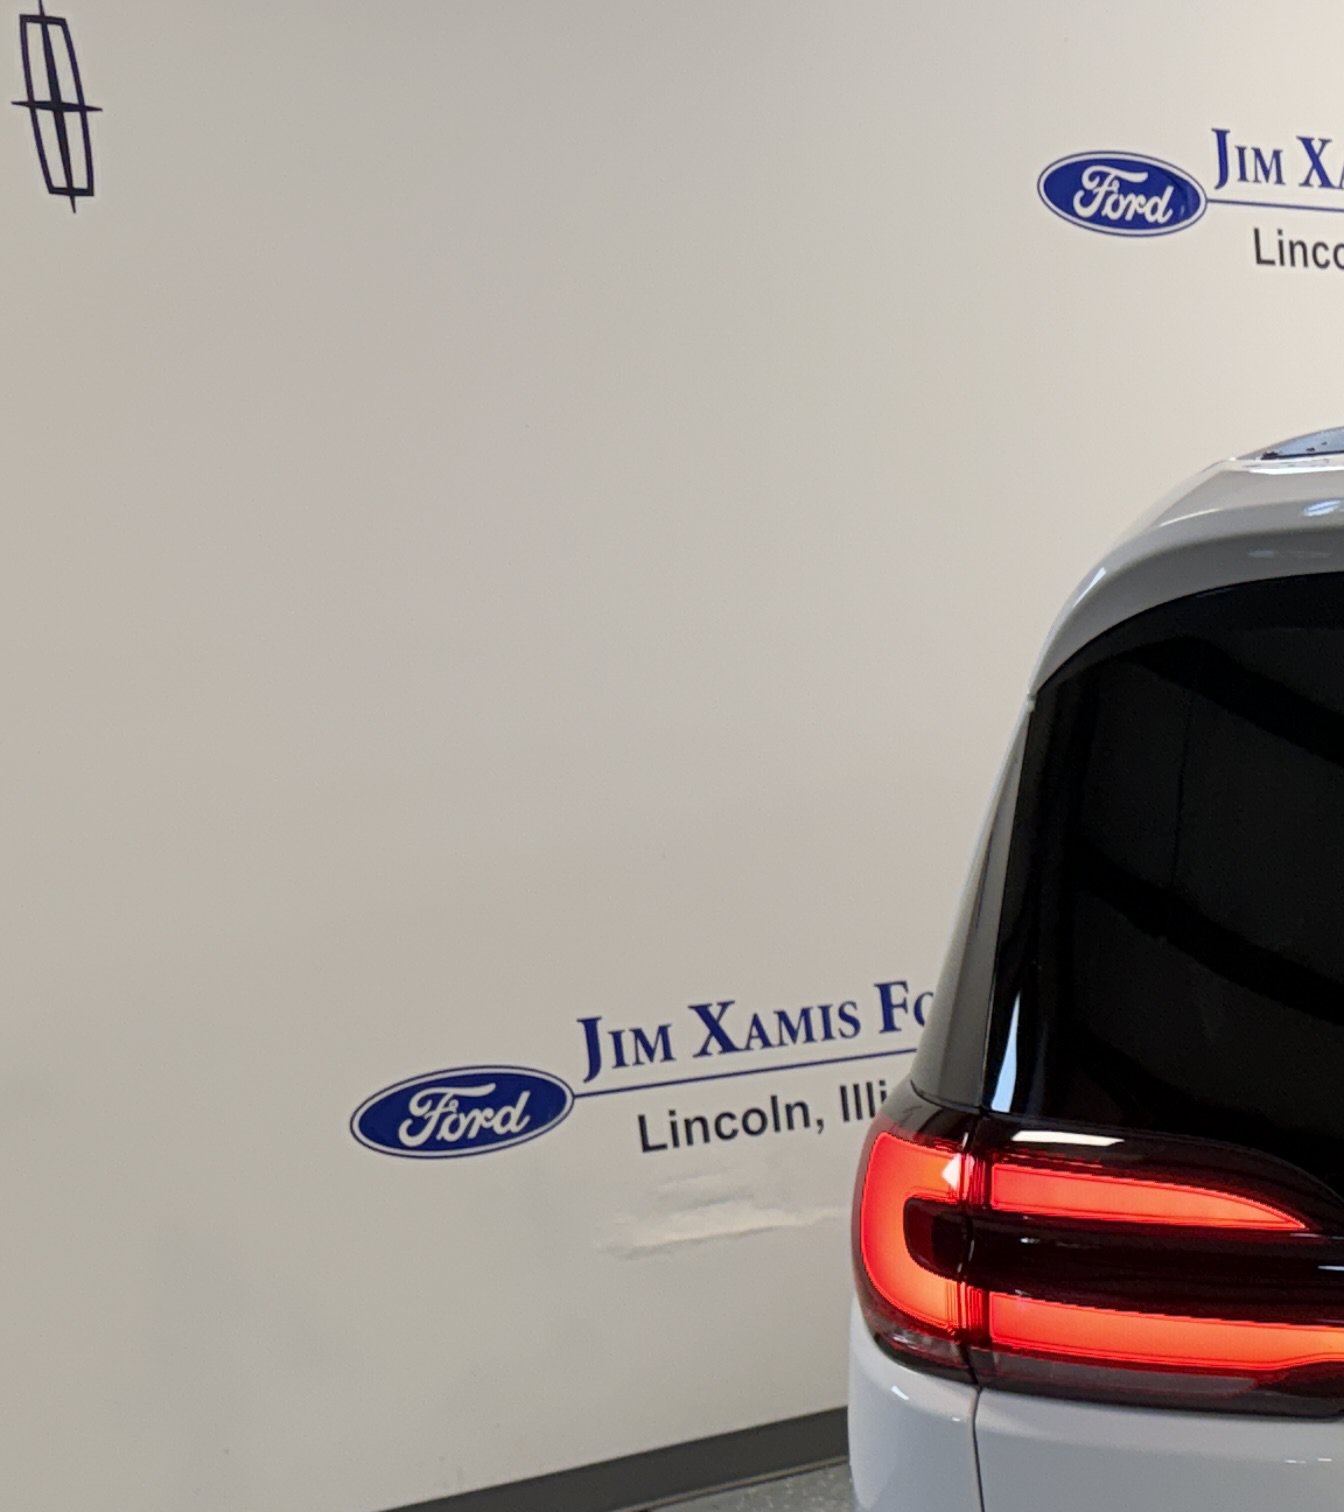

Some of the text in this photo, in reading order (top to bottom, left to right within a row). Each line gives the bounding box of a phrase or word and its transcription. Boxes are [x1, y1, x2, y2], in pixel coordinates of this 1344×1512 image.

[1211, 128, 1285, 190] JIM
[1072, 164, 1174, 223] Ford
[576, 1015, 677, 1083] JIM
[688, 1000, 862, 1058] XAMIS
[398, 1082, 531, 1148] Ford
[638, 1094, 825, 1153] Lincoln,
